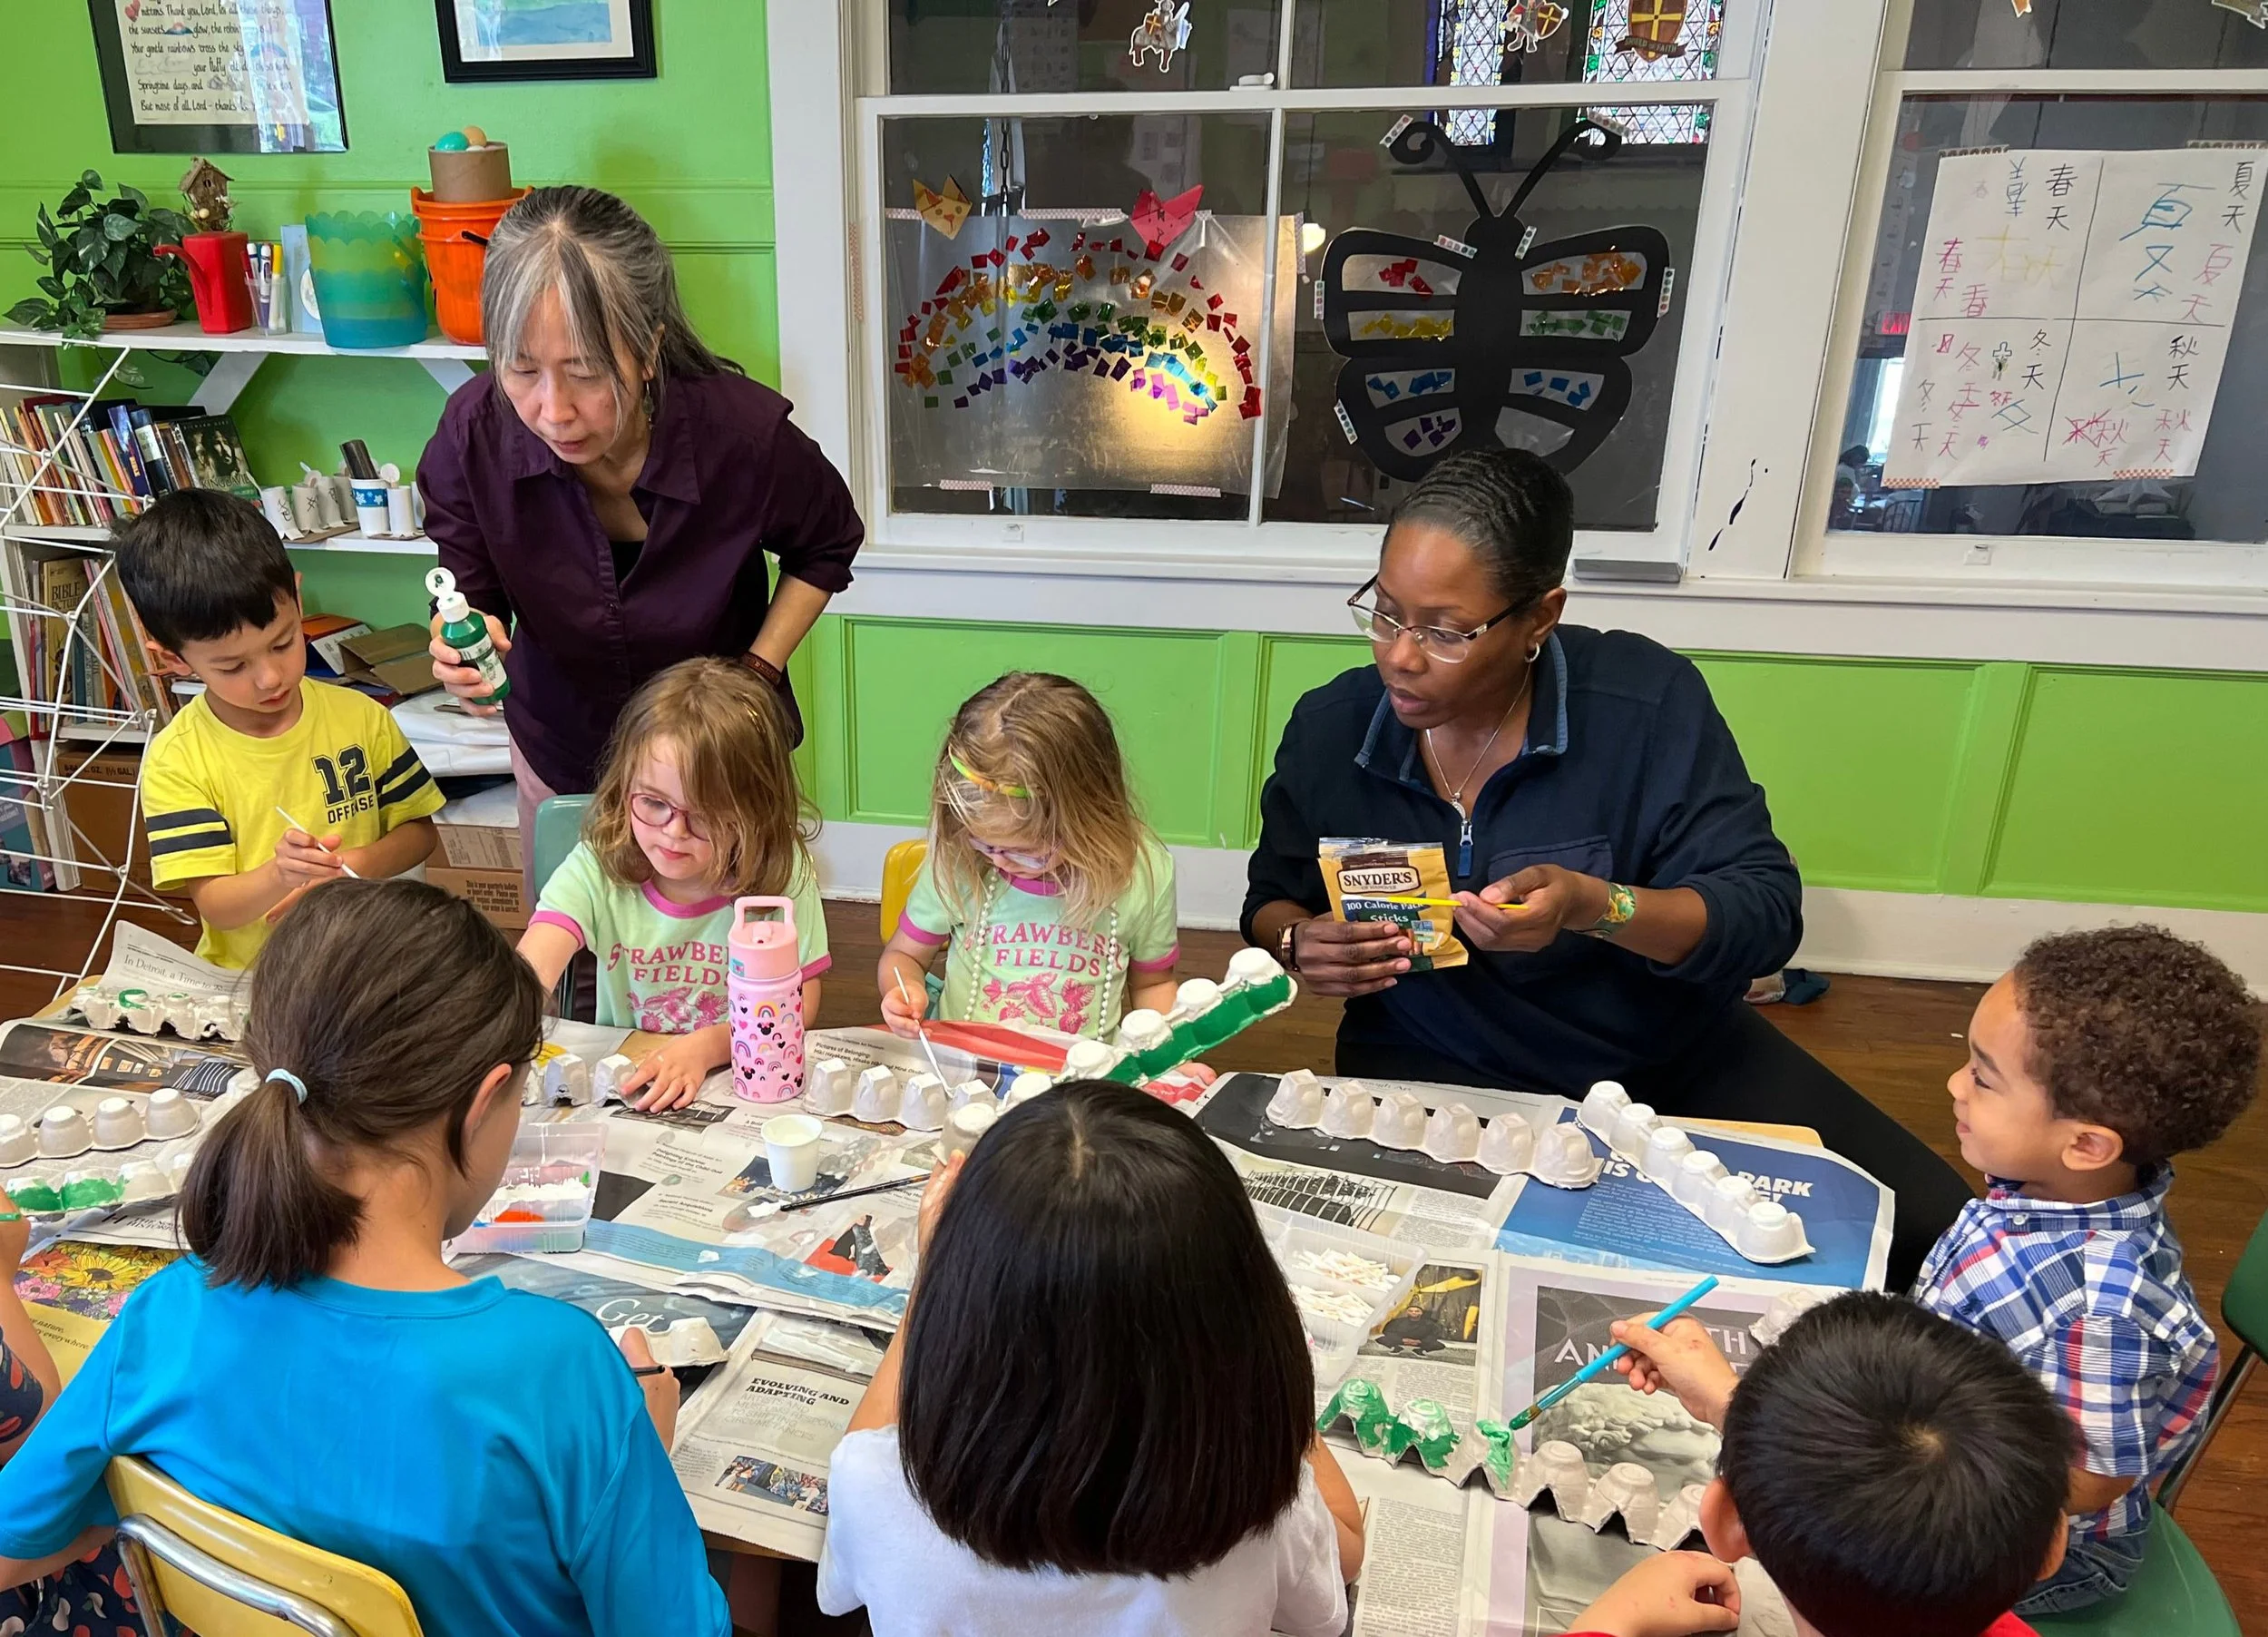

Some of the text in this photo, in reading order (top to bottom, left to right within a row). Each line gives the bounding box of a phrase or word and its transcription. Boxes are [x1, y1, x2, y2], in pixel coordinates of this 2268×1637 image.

[166, 3, 186, 16] Thank
[129, 23, 139, 34] the
[211, 21, 222, 34] the
[145, 41, 163, 57] gentle
[168, 42, 196, 54] rainbows
[219, 40, 230, 53] the
[1656, 44, 1677, 53] FAITH
[192, 64, 207, 76] your
[191, 79, 203, 90] and
[141, 99, 153, 111] But
[215, 97, 237, 111] thanks
[2045, 163, 2079, 231] 春天
[2222, 161, 2254, 233] 夏天
[2021, 328, 2052, 390] 冬天
[2166, 335, 2200, 391] 秋天
[52, 582, 80, 601] BIBLE
[311, 743, 373, 808] 12
[1343, 871, 1413, 887] SNYDER'S
[1346, 902, 1362, 911] 100
[1370, 913, 1409, 923] Sticks
[124, 955, 133, 966] In
[135, 956, 167, 978] Detroit,
[177, 970, 200, 987] Time
[994, 947, 1100, 977] FIELDS
[816, 1042, 836, 1053] Pictures
[837, 1045, 844, 1054] of
[1737, 1171, 1814, 1198] PARK
[595, 1298, 665, 1330] Get
[745, 1385, 817, 1406] ADAPTING
[751, 1377, 850, 1406] EVOLVING AND
